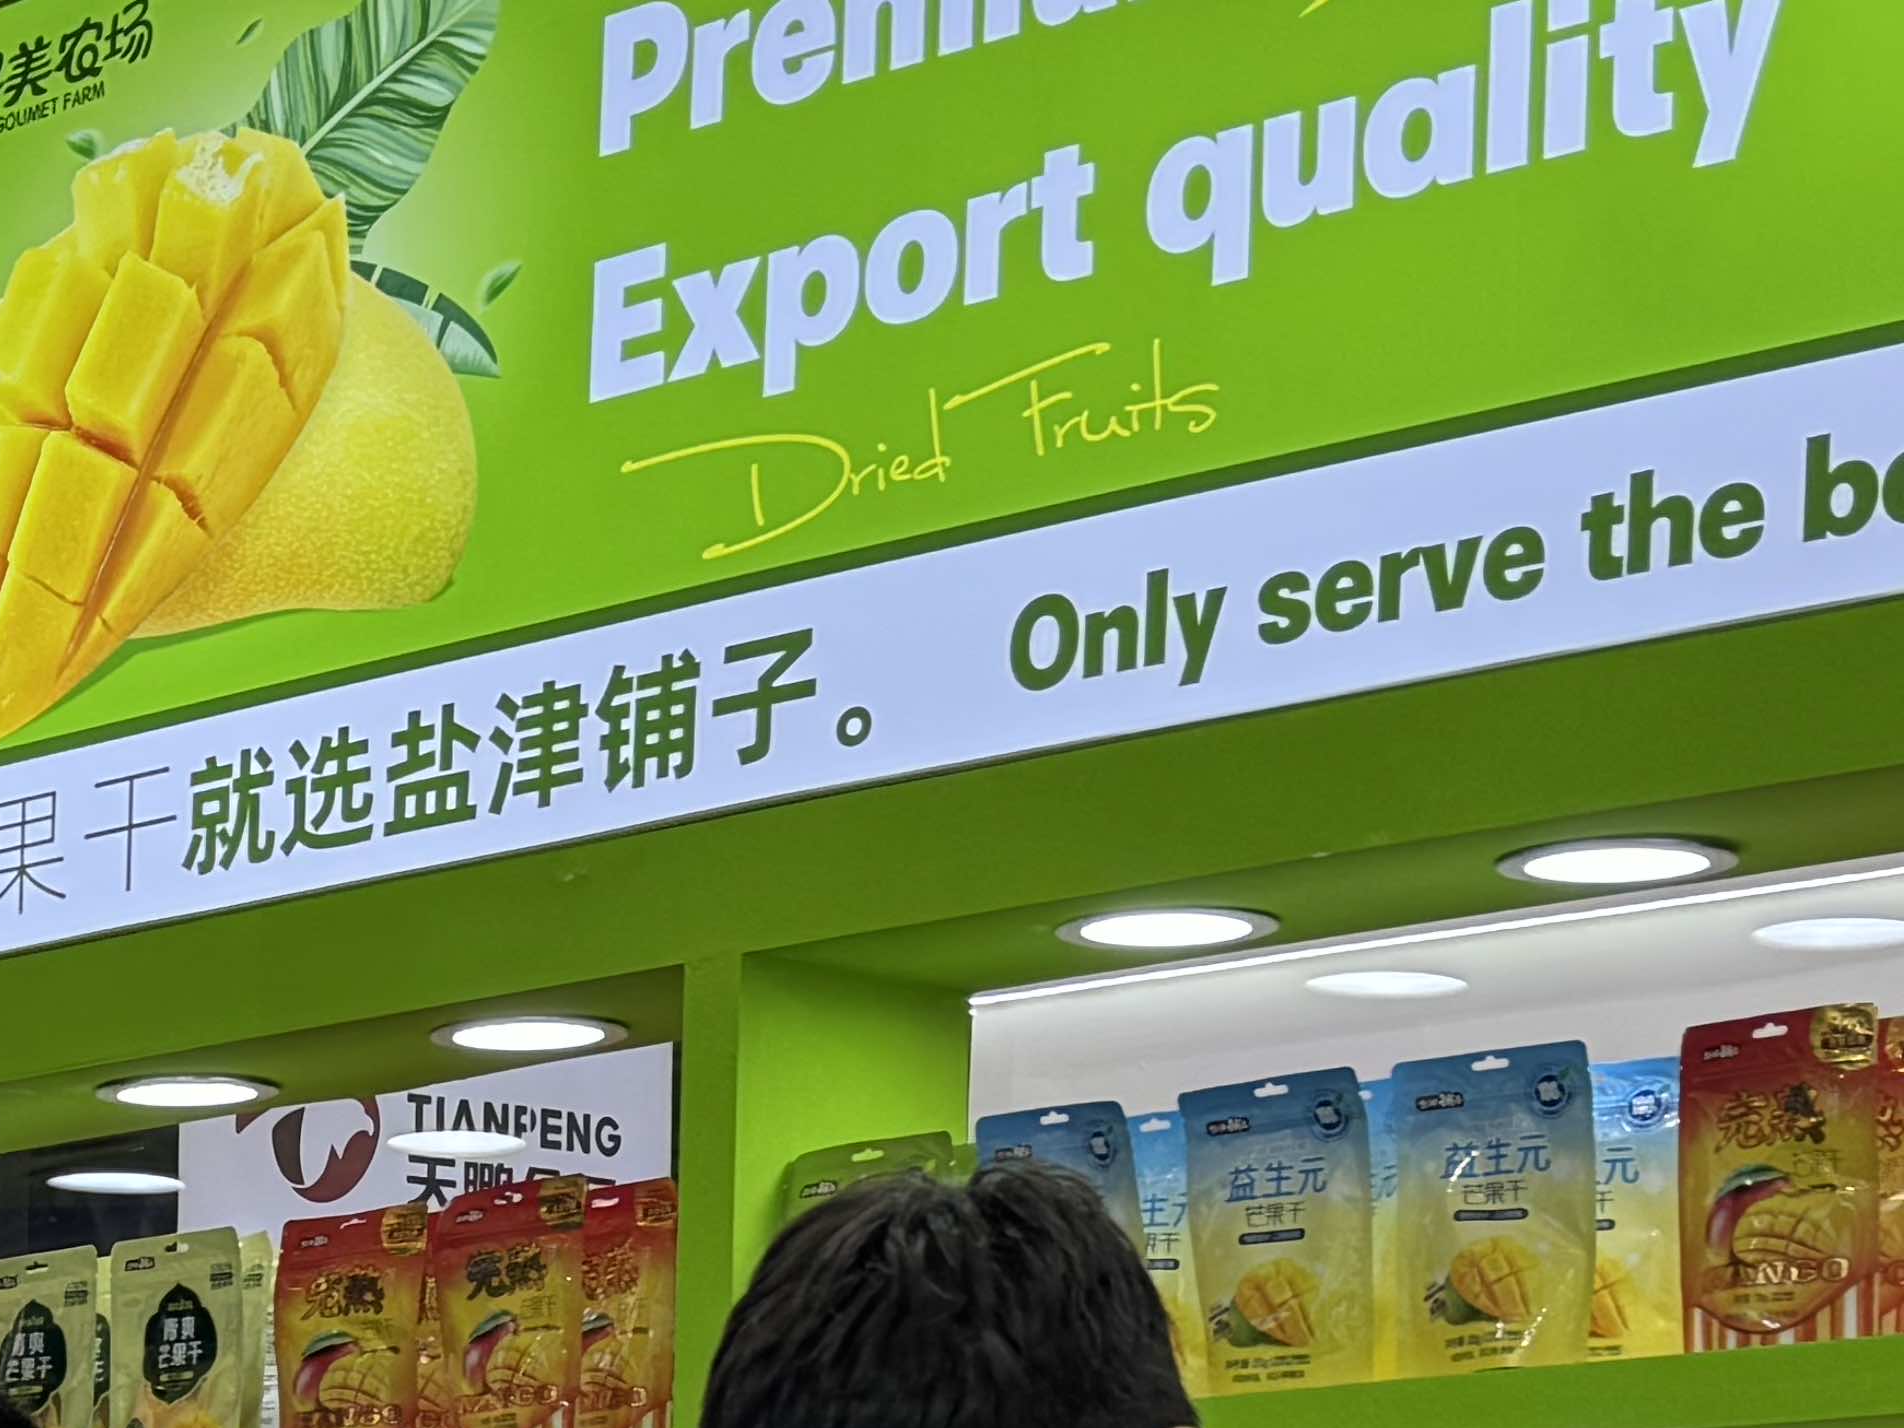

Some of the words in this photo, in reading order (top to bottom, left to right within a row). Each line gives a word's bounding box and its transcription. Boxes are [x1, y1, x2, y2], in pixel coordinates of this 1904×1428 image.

[62, 80, 106, 113] FARM
[598, 0, 1138, 157] Prem
[589, 142, 1099, 404] Export
[1145, 0, 1784, 287] quality
[622, 386, 952, 560] Dried
[944, 336, 1222, 456] Fruits
[1008, 568, 1228, 694] Only
[1258, 526, 1546, 646] serve
[1581, 468, 1767, 583] the
[1224, 1156, 1328, 1203] 益生元
[1441, 1133, 1552, 1181] 益生元
[1244, 1202, 1308, 1229] 芒果干
[1461, 1179, 1530, 1206] 芒果干
